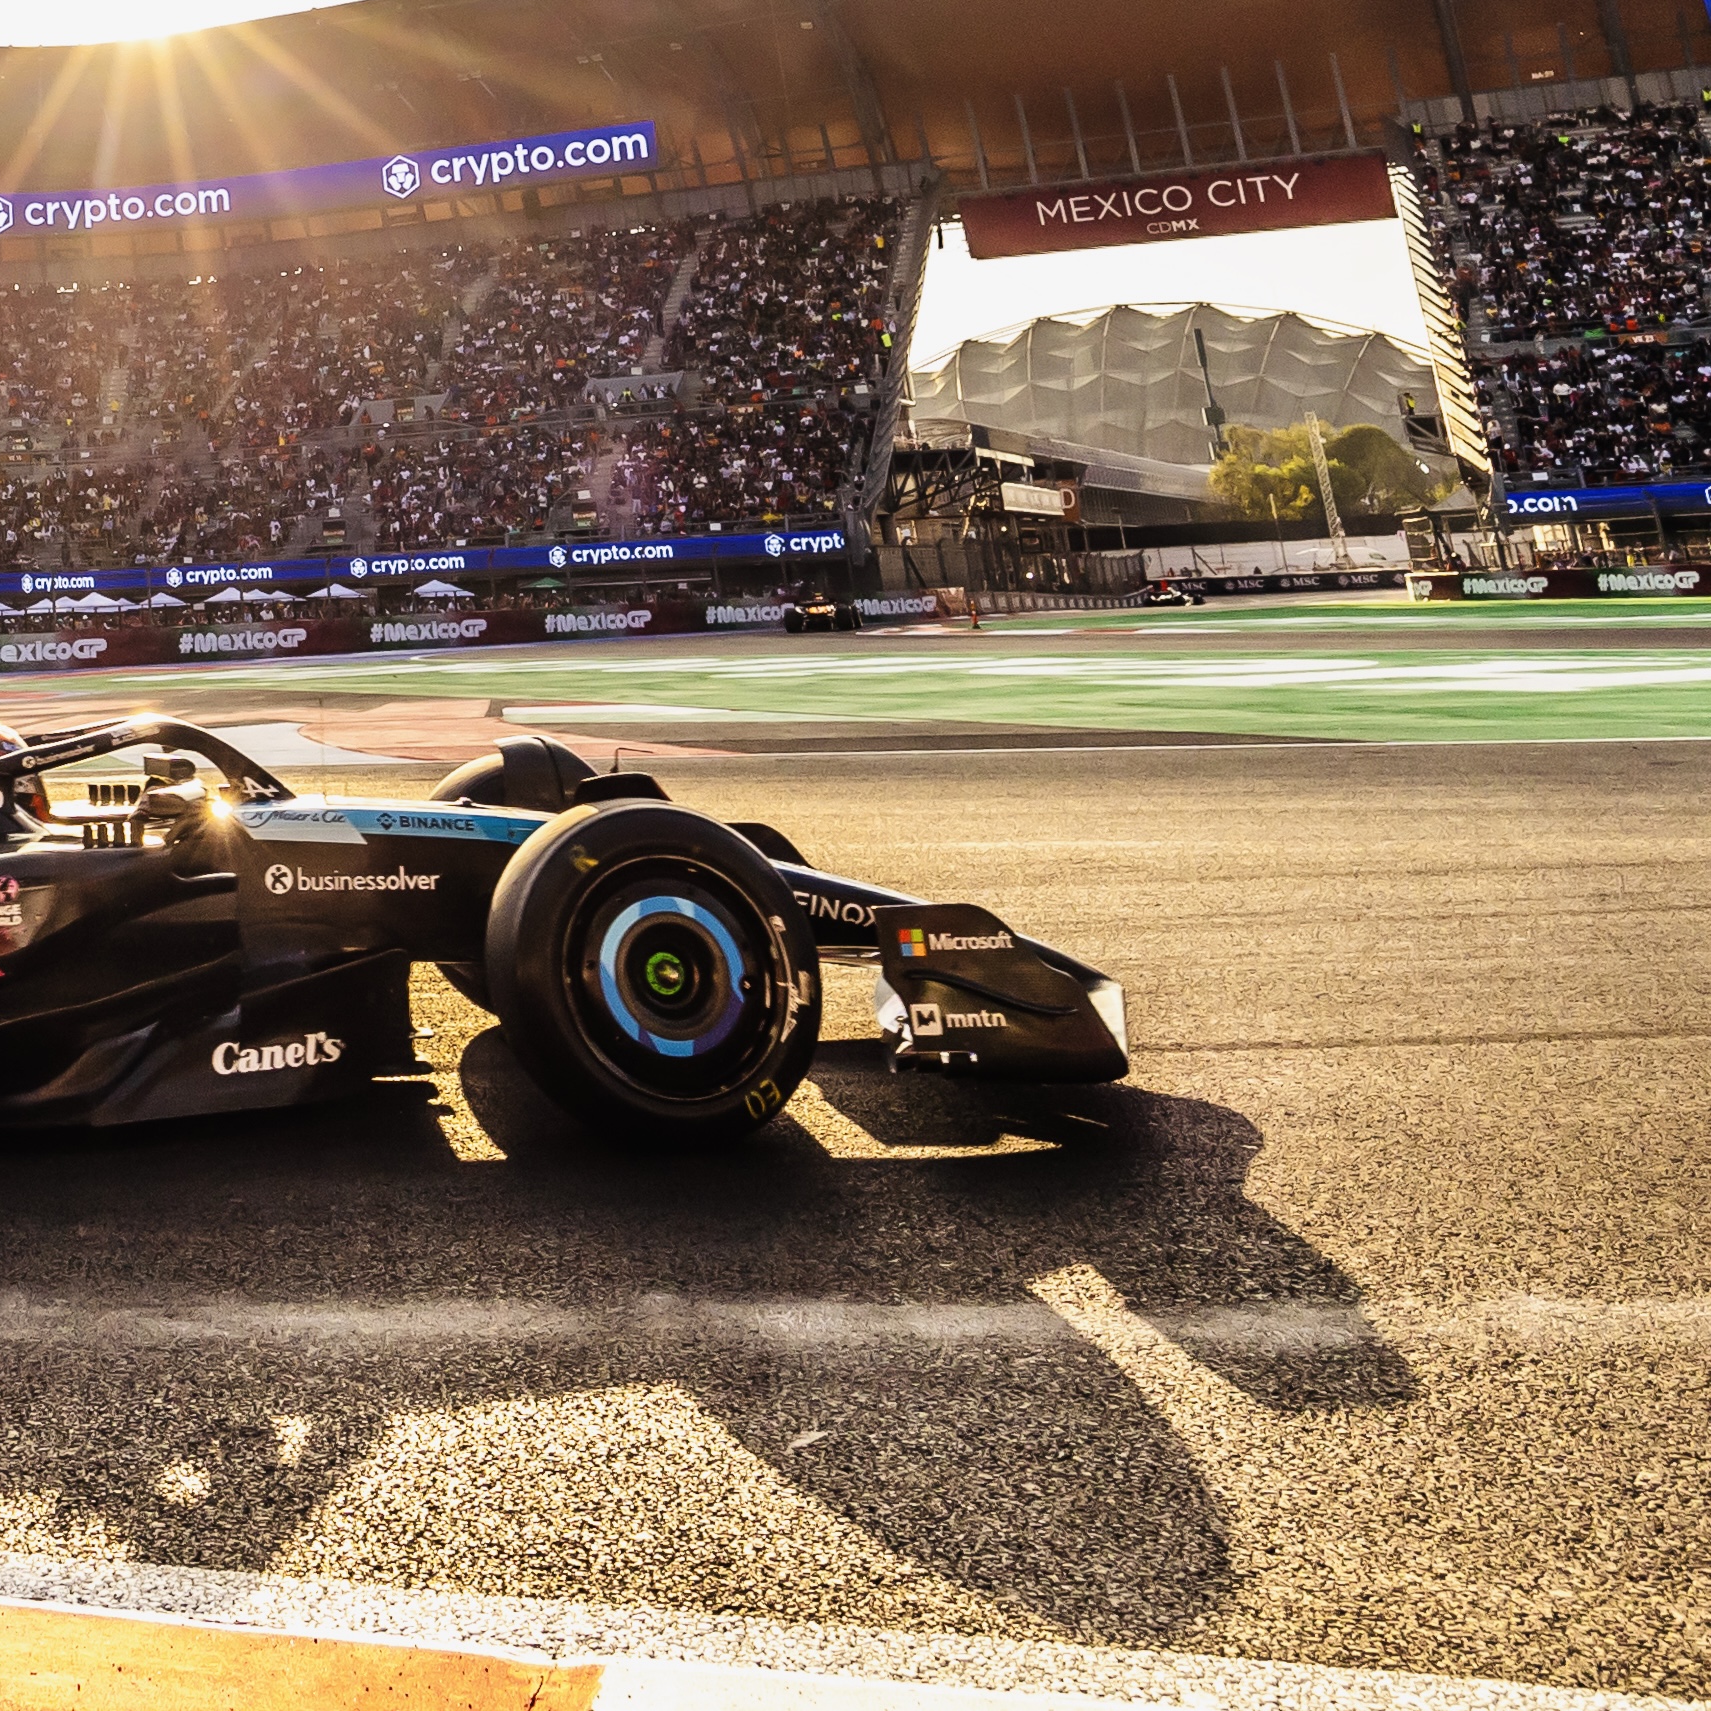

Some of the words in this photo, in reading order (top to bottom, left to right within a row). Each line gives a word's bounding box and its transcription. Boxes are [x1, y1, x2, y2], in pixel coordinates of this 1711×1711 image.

[431, 129, 648, 186] crypto.com
[24, 185, 230, 230] crypto.com
[1036, 185, 1193, 226] MEXICO
[1207, 173, 1300, 207] CITY
[1146, 217, 1200, 235] CDMX
[572, 543, 674, 564] crypto.com
[186, 566, 273, 585] crypto.com
[1237, 579, 1265, 589] MSC
[1293, 576, 1320, 587] MSC
[1351, 574, 1379, 584] MSC
[1462, 576, 1548, 594] #MexicoGP
[1598, 571, 1700, 592] #MexicoGP
[371, 618, 487, 643] #MexicoGP
[545, 609, 652, 633] #MexicoGP
[179, 628, 307, 654] #MexicoGP
[399, 815, 475, 831] BINANCE
[297, 865, 441, 892] businessolver
[928, 929, 1015, 952] Microsoft
[946, 1008, 1007, 1030] mntn
[212, 1031, 345, 1075] Canel's
